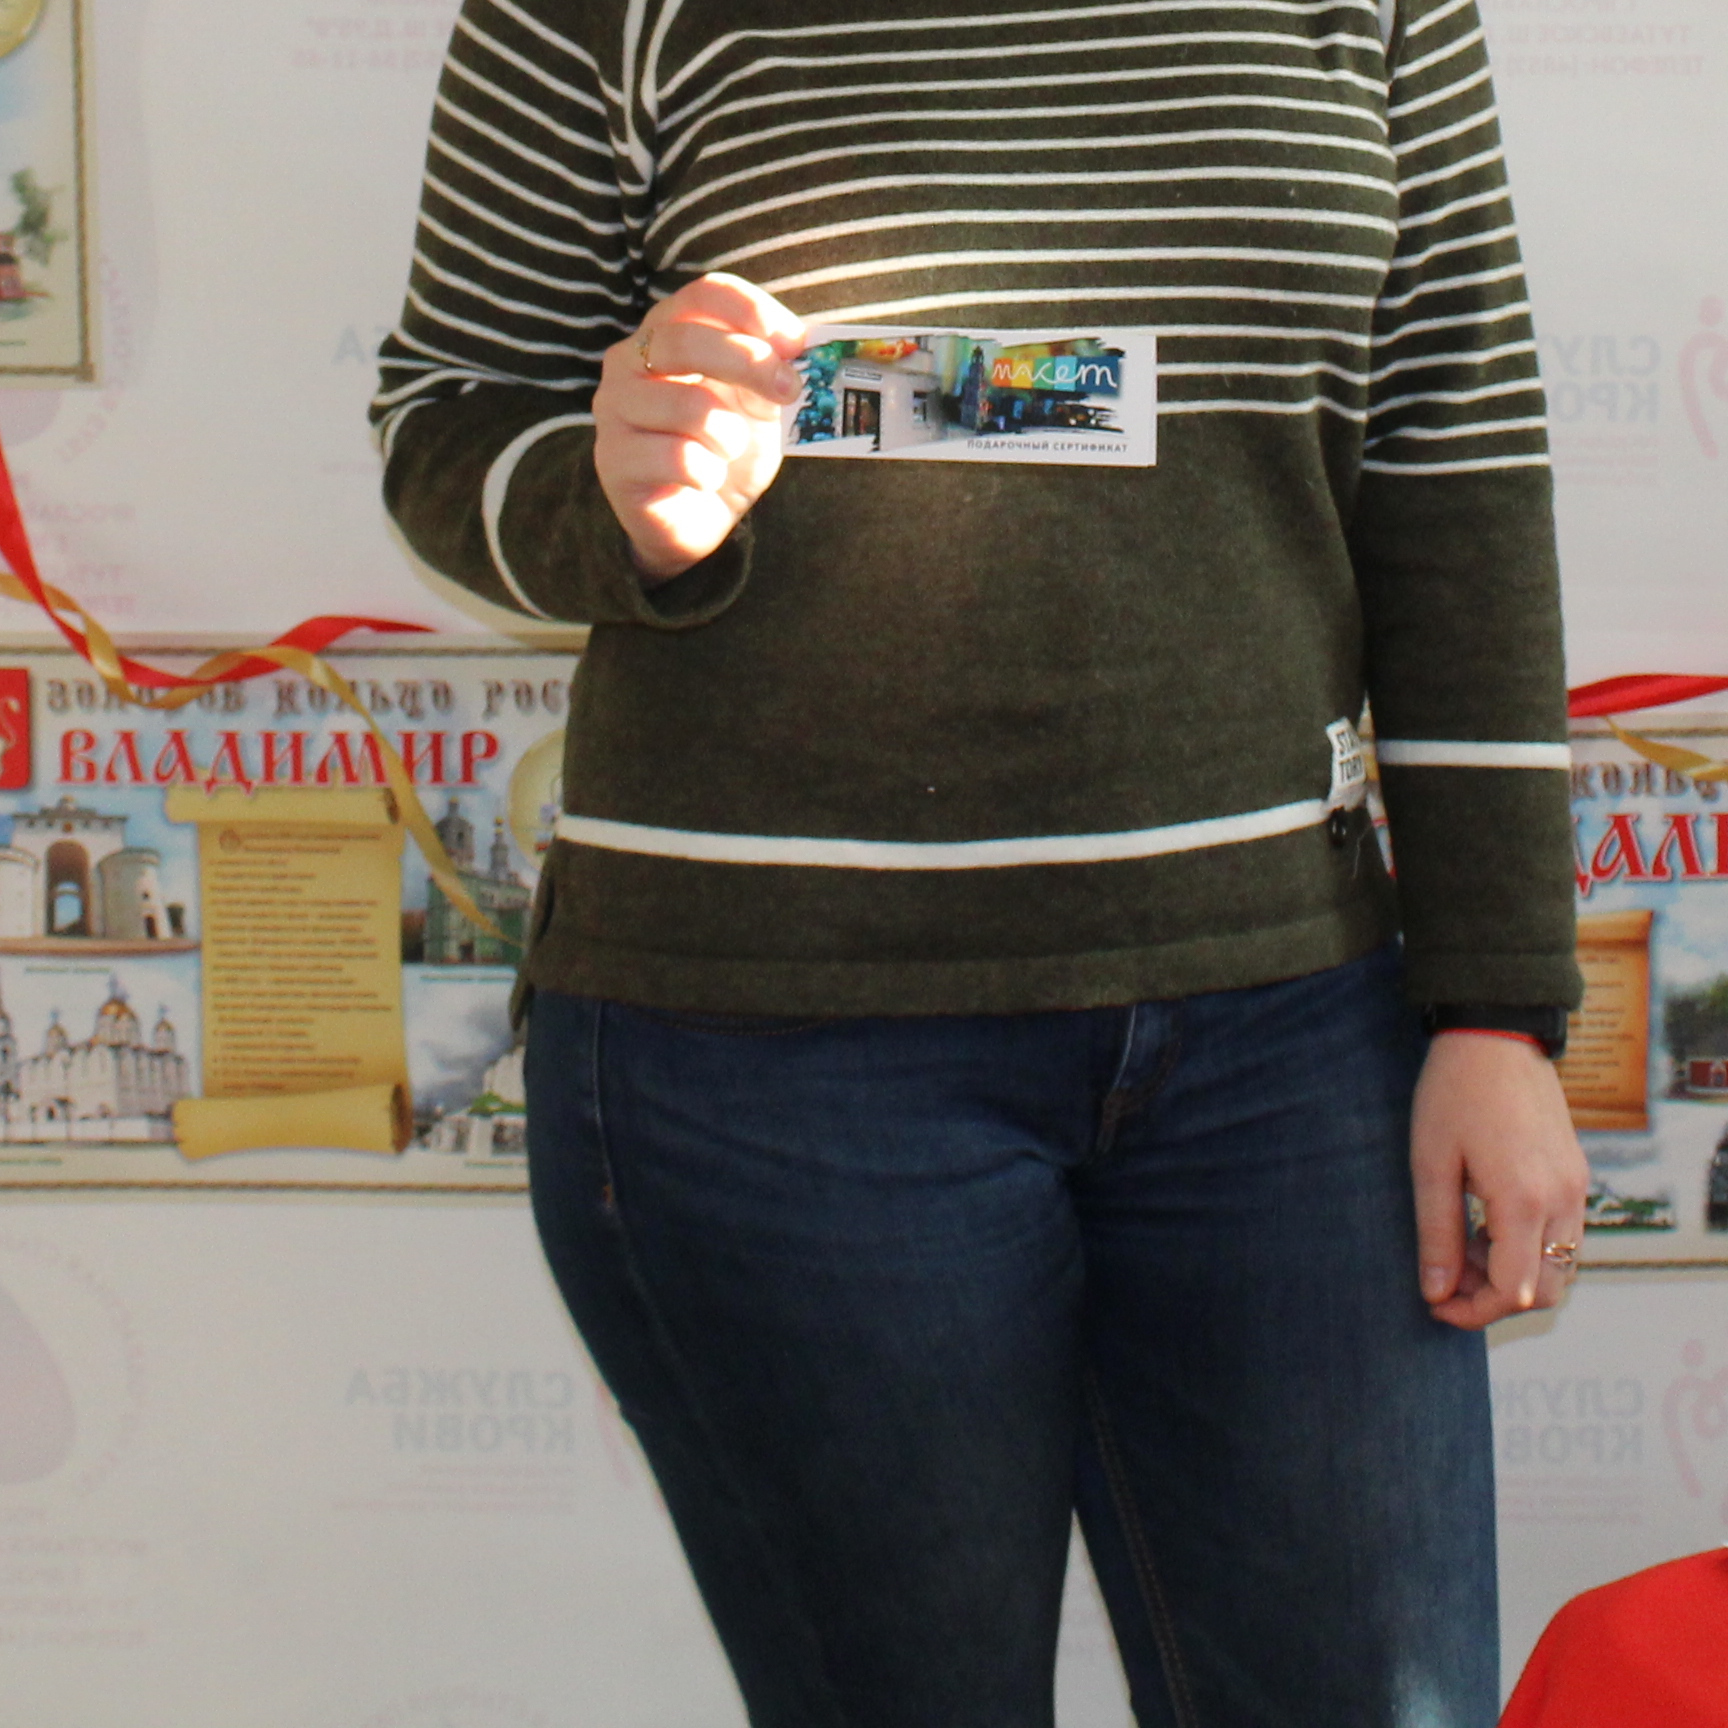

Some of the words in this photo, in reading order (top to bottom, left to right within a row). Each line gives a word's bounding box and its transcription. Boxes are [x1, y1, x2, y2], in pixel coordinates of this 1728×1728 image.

[967, 440, 1049, 451] ПОДАРОЧНЫЙ
[1053, 442, 1128, 453] СЕРТИФИКАТ
[47, 678, 248, 714] ЗОЛООЕ
[482, 678, 571, 718] РОС
[56, 728, 500, 796] ВЛАДИМИР
